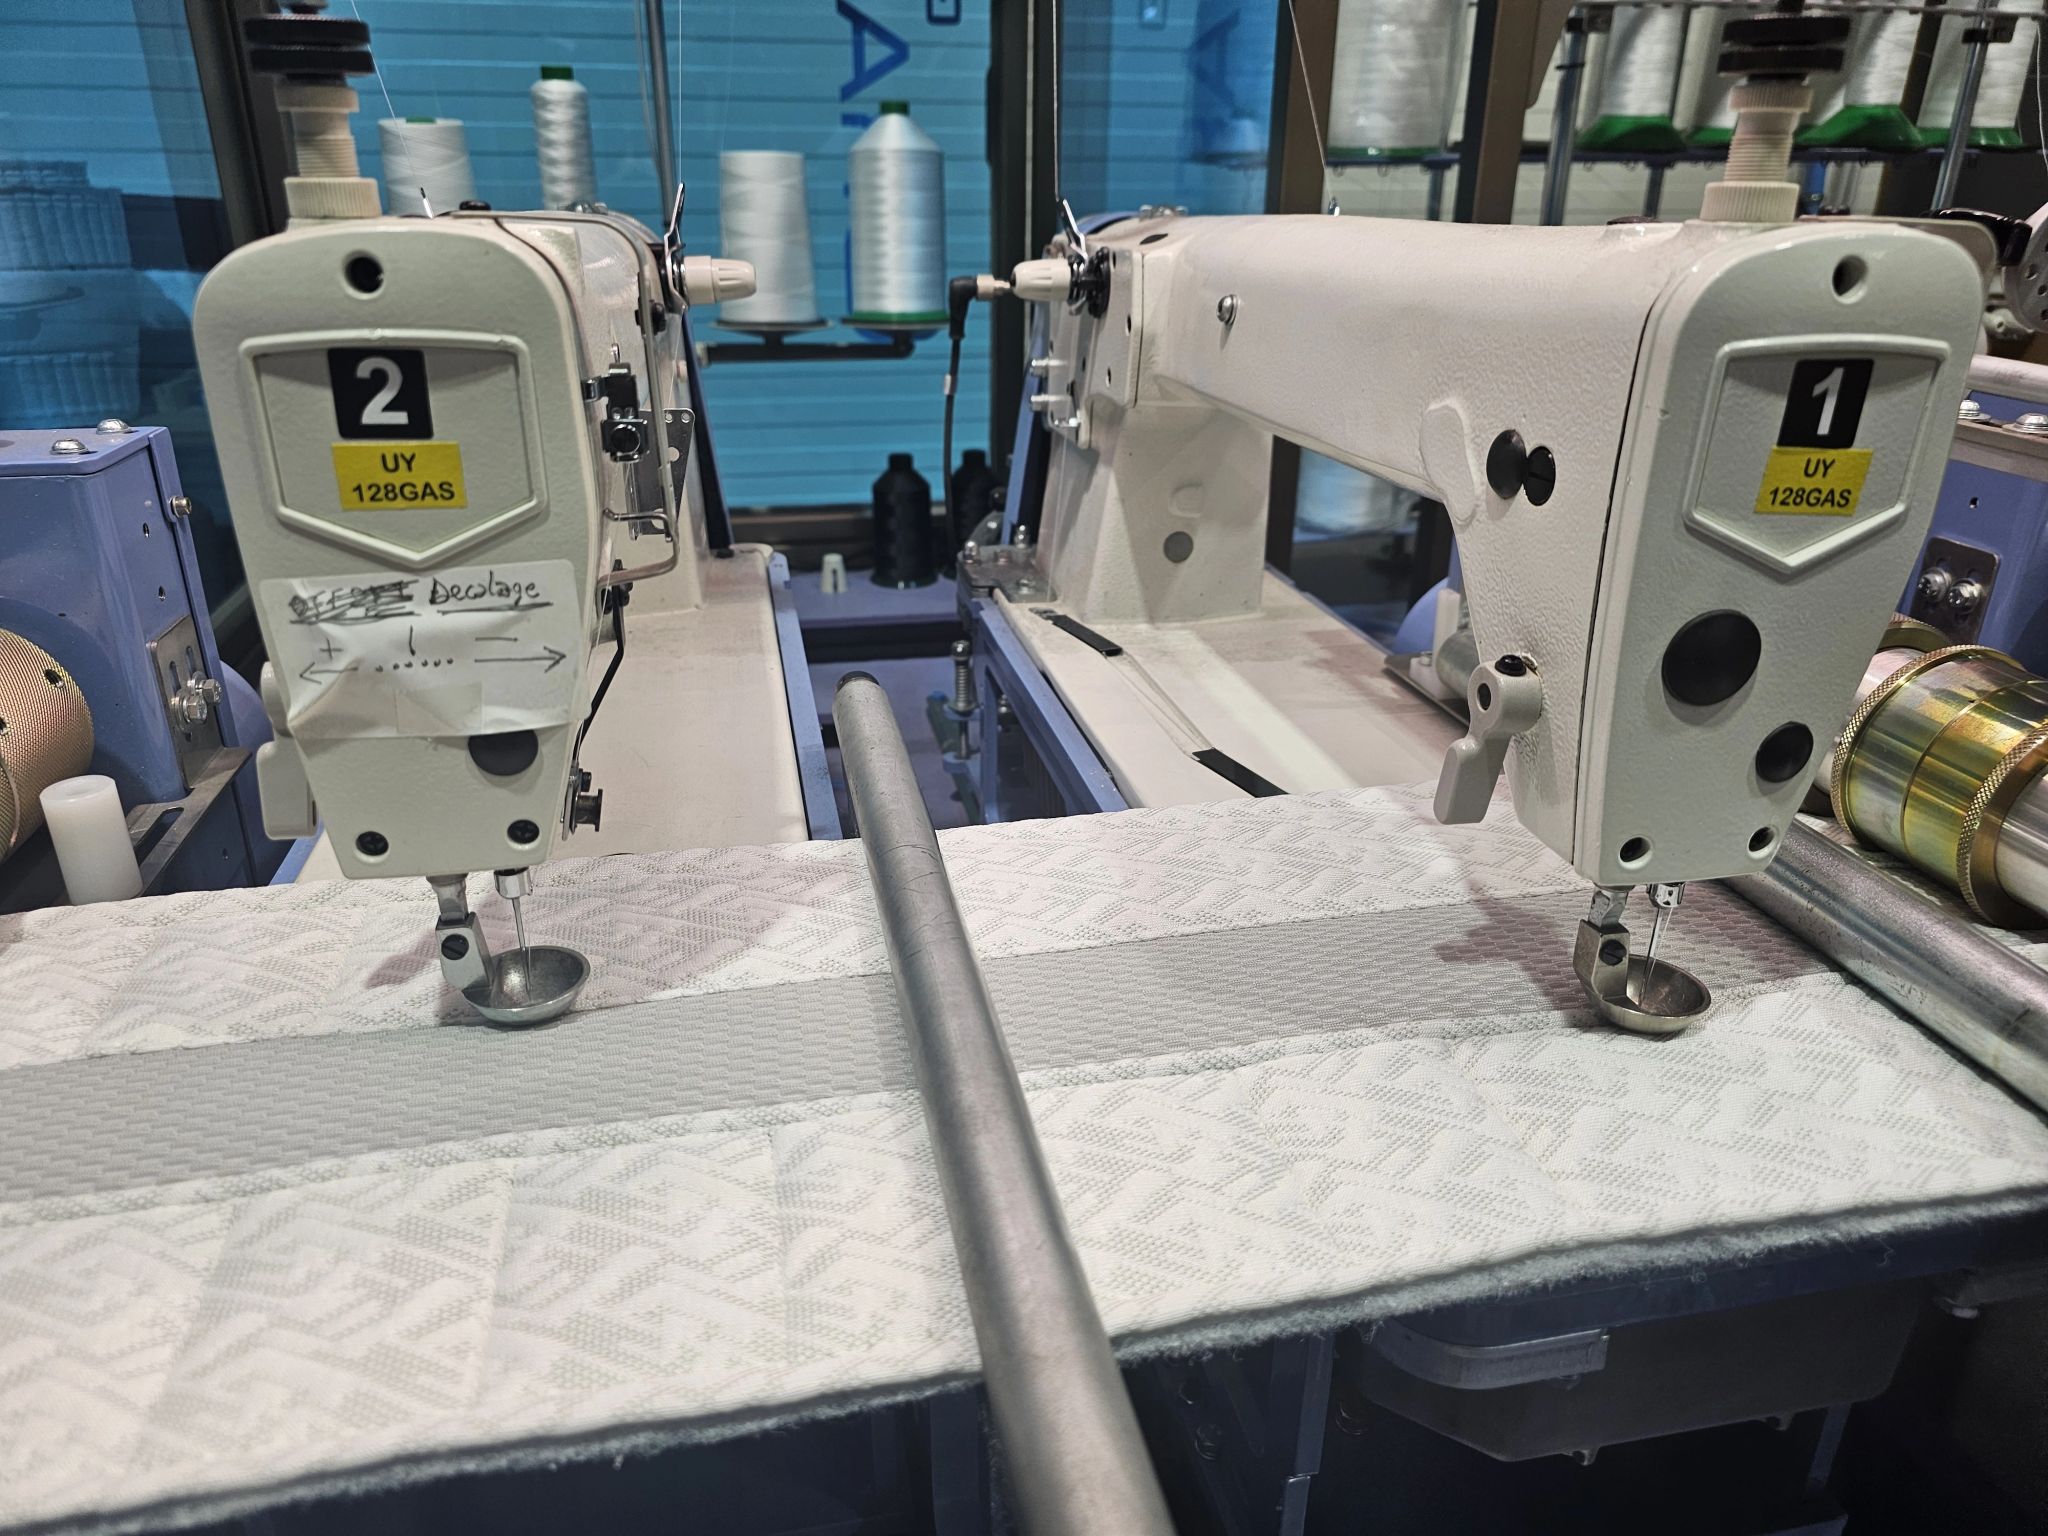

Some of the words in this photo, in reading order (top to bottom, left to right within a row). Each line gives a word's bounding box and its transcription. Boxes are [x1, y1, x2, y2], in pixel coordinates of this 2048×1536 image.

[356, 356, 409, 425] 2
[1812, 367, 1844, 435] 1
[381, 453, 416, 473] UY
[1803, 458, 1835, 478] UY
[352, 481, 455, 503] 128GAS
[1769, 487, 1852, 508] 128GAS
